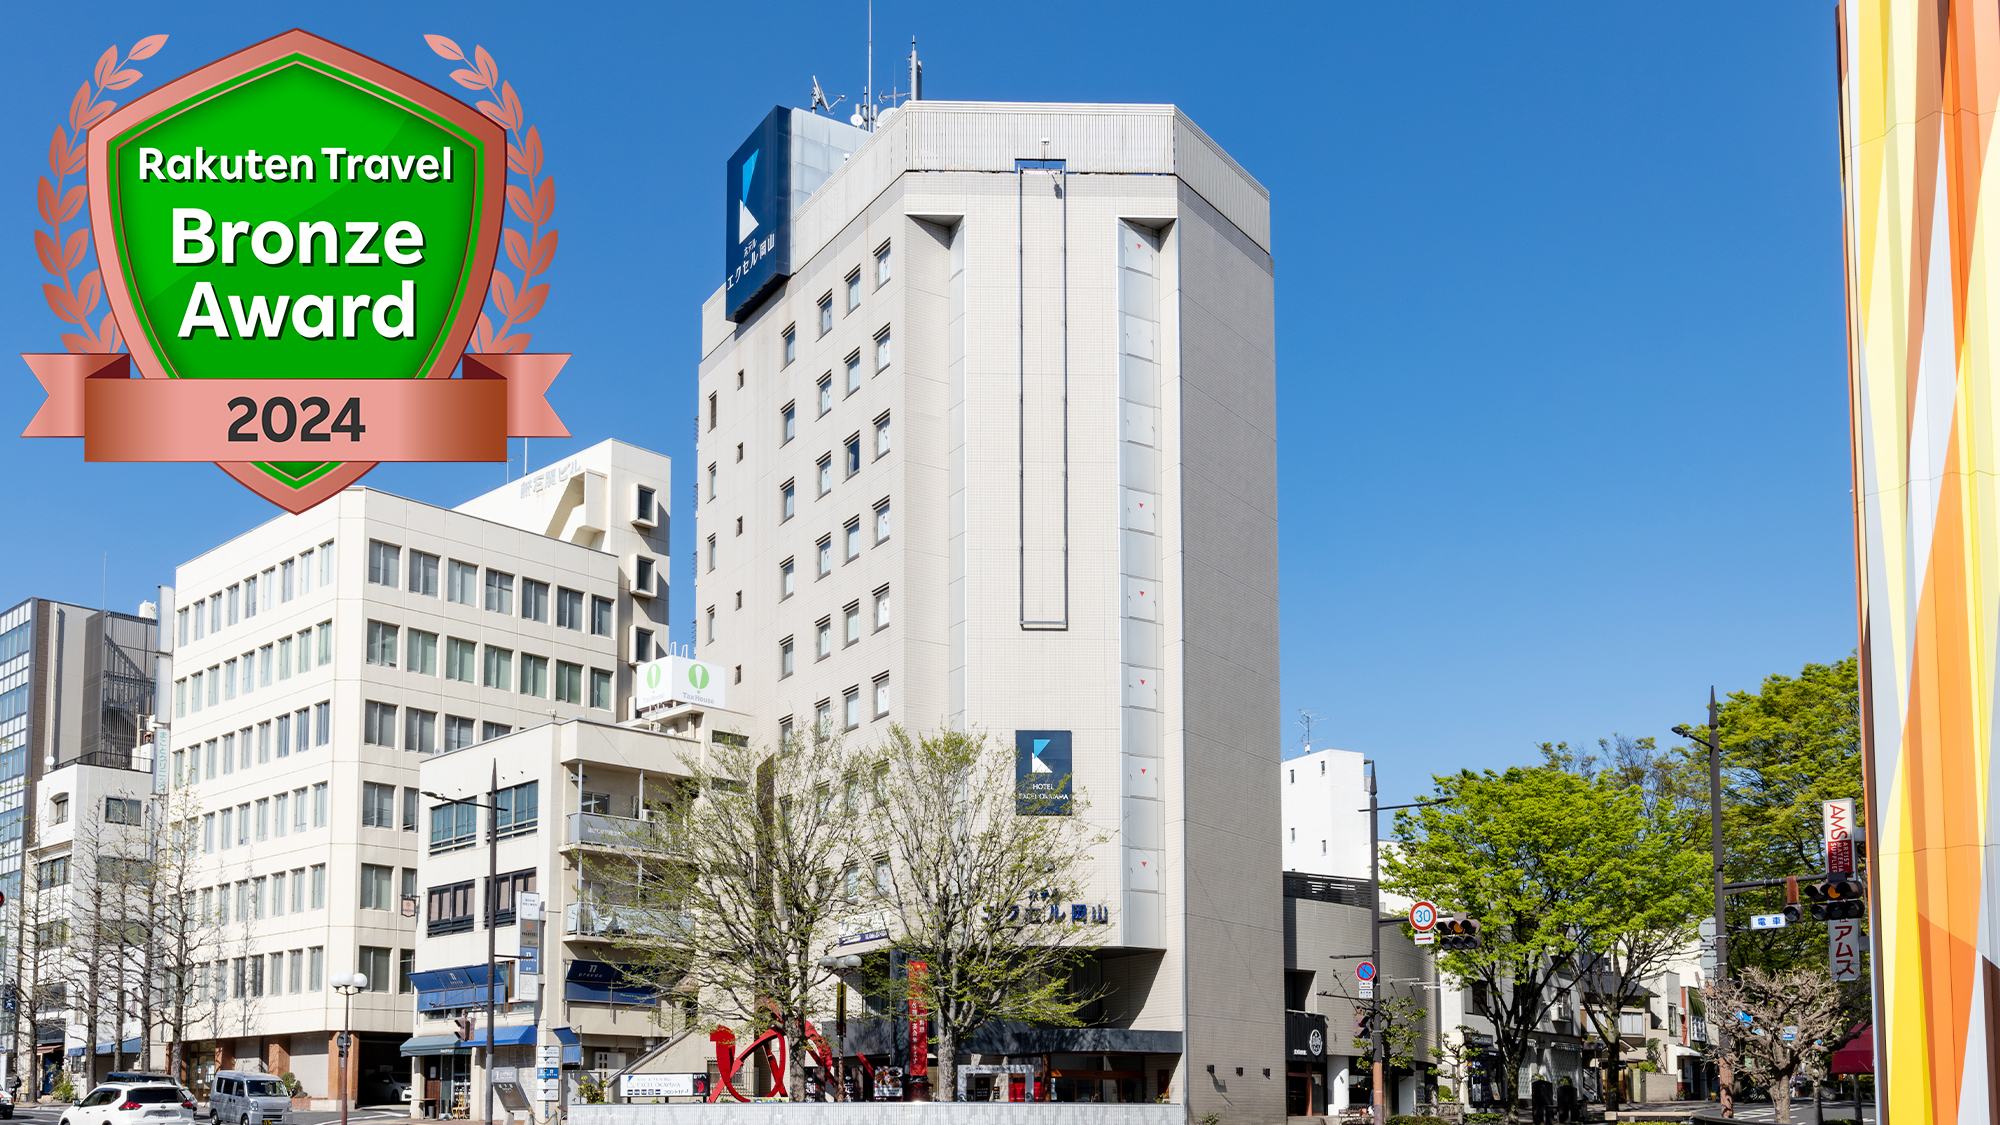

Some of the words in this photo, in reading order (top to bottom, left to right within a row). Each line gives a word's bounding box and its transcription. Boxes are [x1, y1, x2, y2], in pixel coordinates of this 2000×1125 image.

[726, 233, 775, 291] エクセル岡山
[743, 238, 758, 258] ホテル
[1829, 804, 1848, 841] AMS
[1415, 909, 1431, 923] 30
[1757, 917, 1781, 926] 電車
[1834, 919, 1855, 976] アムス
